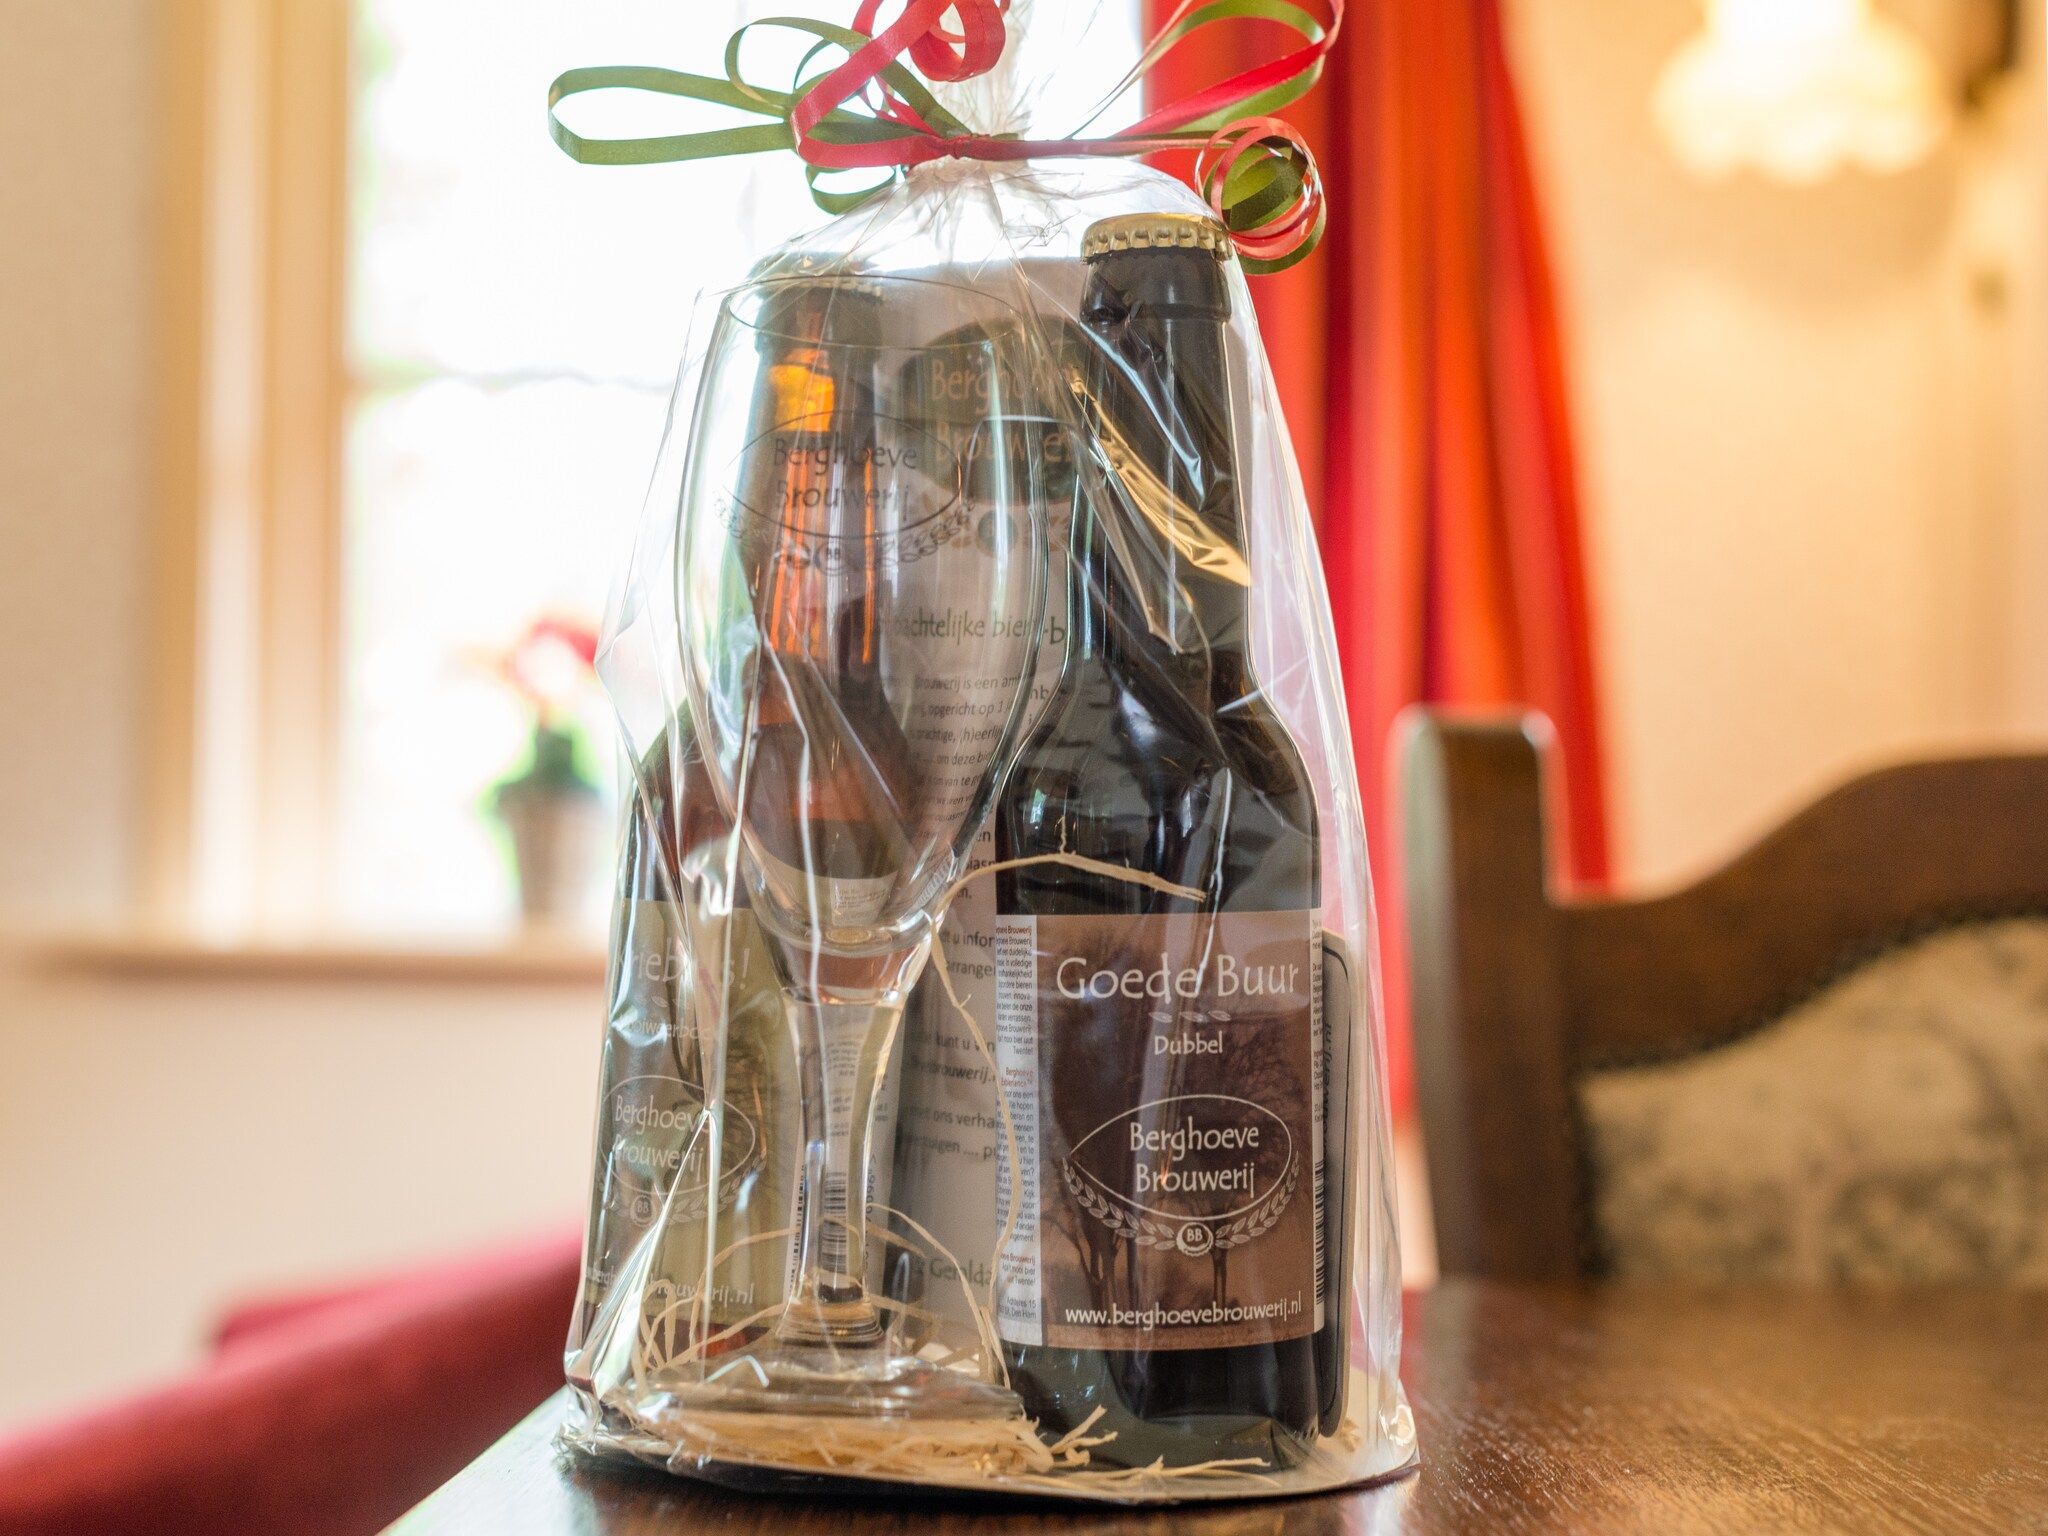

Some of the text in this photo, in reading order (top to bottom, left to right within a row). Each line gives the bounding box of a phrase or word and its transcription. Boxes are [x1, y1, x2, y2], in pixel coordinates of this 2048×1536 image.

[1056, 952, 1299, 1004] Goede Buur
[1153, 1031, 1224, 1056] Dubbel
[1129, 1115, 1260, 1162] Berghoeve
[1135, 1162, 1255, 1199] Brouwerij
[1186, 1228, 1203, 1242] BB
[1065, 1290, 1302, 1331] www.berghoevebrouwerij.nl
